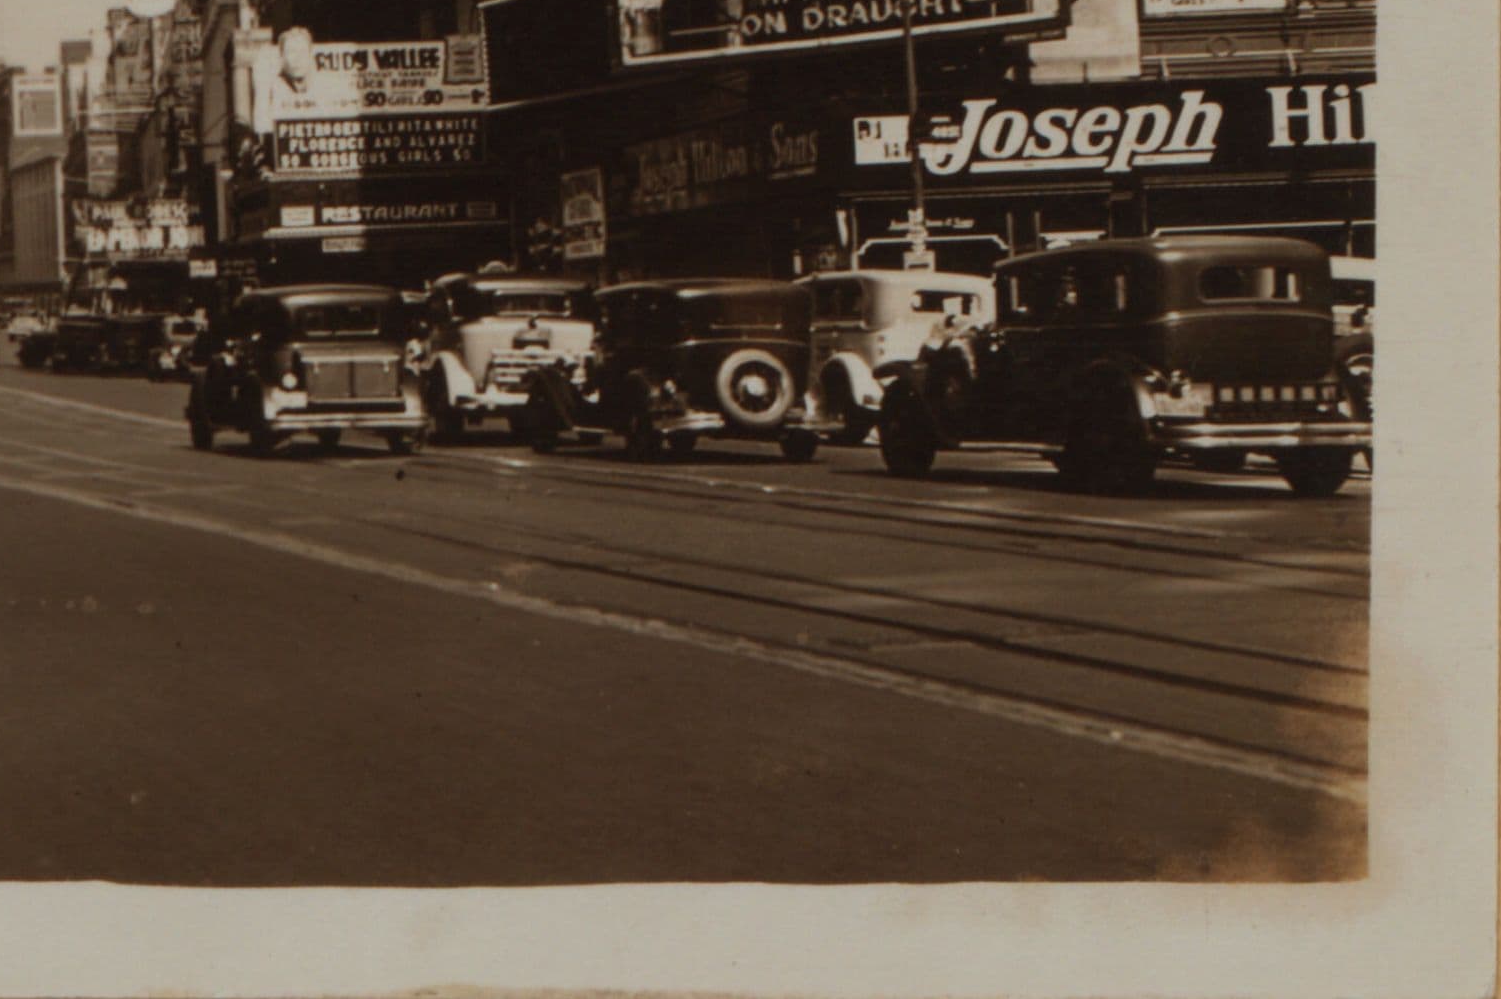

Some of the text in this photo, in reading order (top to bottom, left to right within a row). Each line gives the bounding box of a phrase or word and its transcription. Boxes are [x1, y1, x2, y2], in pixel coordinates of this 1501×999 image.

[740, 10, 788, 37] ON
[373, 47, 441, 71] VALLEE
[918, 90, 1224, 175] Joseph
